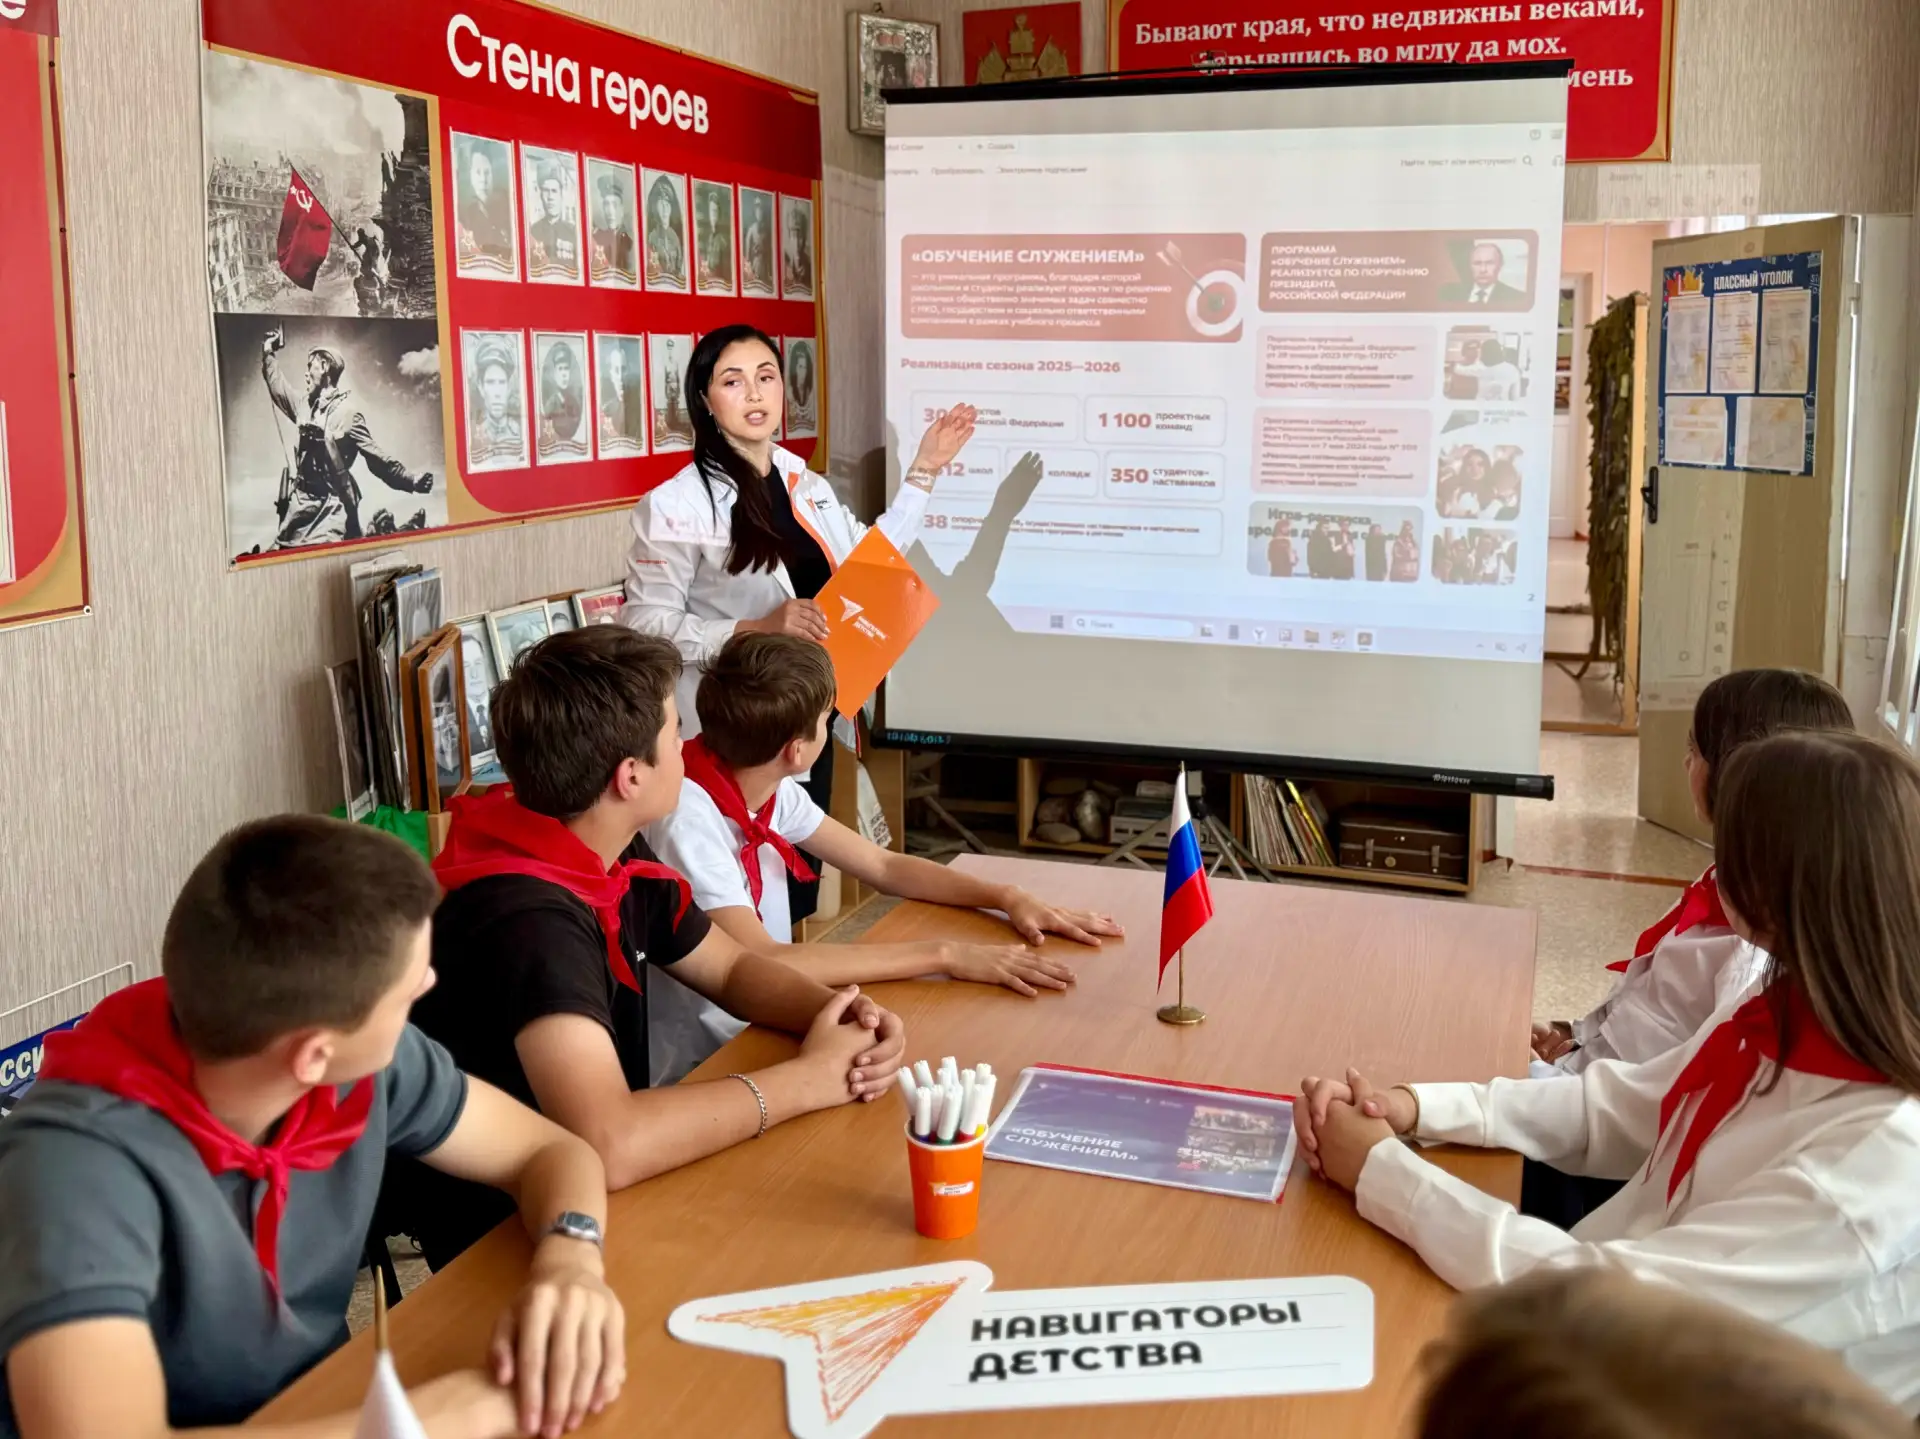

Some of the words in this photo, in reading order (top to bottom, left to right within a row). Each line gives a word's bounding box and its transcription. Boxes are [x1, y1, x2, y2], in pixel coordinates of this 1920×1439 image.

[1135, 22, 1237, 44] Бывают
[1243, 17, 1312, 42] края,
[1318, 13, 1365, 32] что
[1372, 4, 1521, 31] недвижны
[1529, 0, 1645, 20] веками,
[1358, 46, 1389, 64] во
[1395, 41, 1460, 63] мглу
[1466, 39, 1499, 62] да
[1507, 36, 1567, 56] мох.
[446, 13, 581, 104] Стена
[590, 66, 709, 134] героев
[1567, 68, 1634, 88] мень
[911, 249, 1013, 263] «ОБУЧЕНИЕ
[1017, 249, 1145, 264] СЛУЖЕНИЕМ»
[1271, 245, 1337, 255] ПРОГРАММА
[1271, 257, 1331, 266] «ОБУЧЕНИЕ
[1332, 256, 1406, 266] СЛУЖЕНИЕМ»
[1270, 268, 1341, 278] РЕАЛИЗУЕТСЯ
[1343, 267, 1359, 277] ПО
[1361, 267, 1429, 277] ПОРУЧЕНИЮ
[1713, 270, 1758, 291] КЛАССНЫЙ
[1759, 269, 1793, 286] УГОЛОК
[1269, 280, 1336, 289] ПРЕЗИДЕНТА
[1269, 290, 1339, 300] РОССИЙСКОЙ
[1341, 290, 1406, 300] ФЕДЕРАЦИИ
[900, 358, 983, 371] Реализация
[986, 361, 1034, 371] сезона
[1037, 361, 1121, 373] 2025—2026
[1009, 418, 1064, 429] Федерации
[1155, 421, 1193, 432] команд
[1155, 412, 1211, 423] проектных
[938, 461, 965, 477] 12
[968, 465, 994, 475] школ
[1110, 467, 1148, 484] 350
[1153, 467, 1209, 478] студентов-
[1152, 478, 1216, 488] наставников
[923, 514, 949, 530] 38
[1012, 1127, 1123, 1149] «ОБУЧЕНИЕ
[1004, 1134, 1139, 1161] СЛУЖЕНИЕМ»
[970, 1301, 1302, 1342] НАВИГАТОРЫ
[968, 1340, 1203, 1383] ДЕТСТВА
